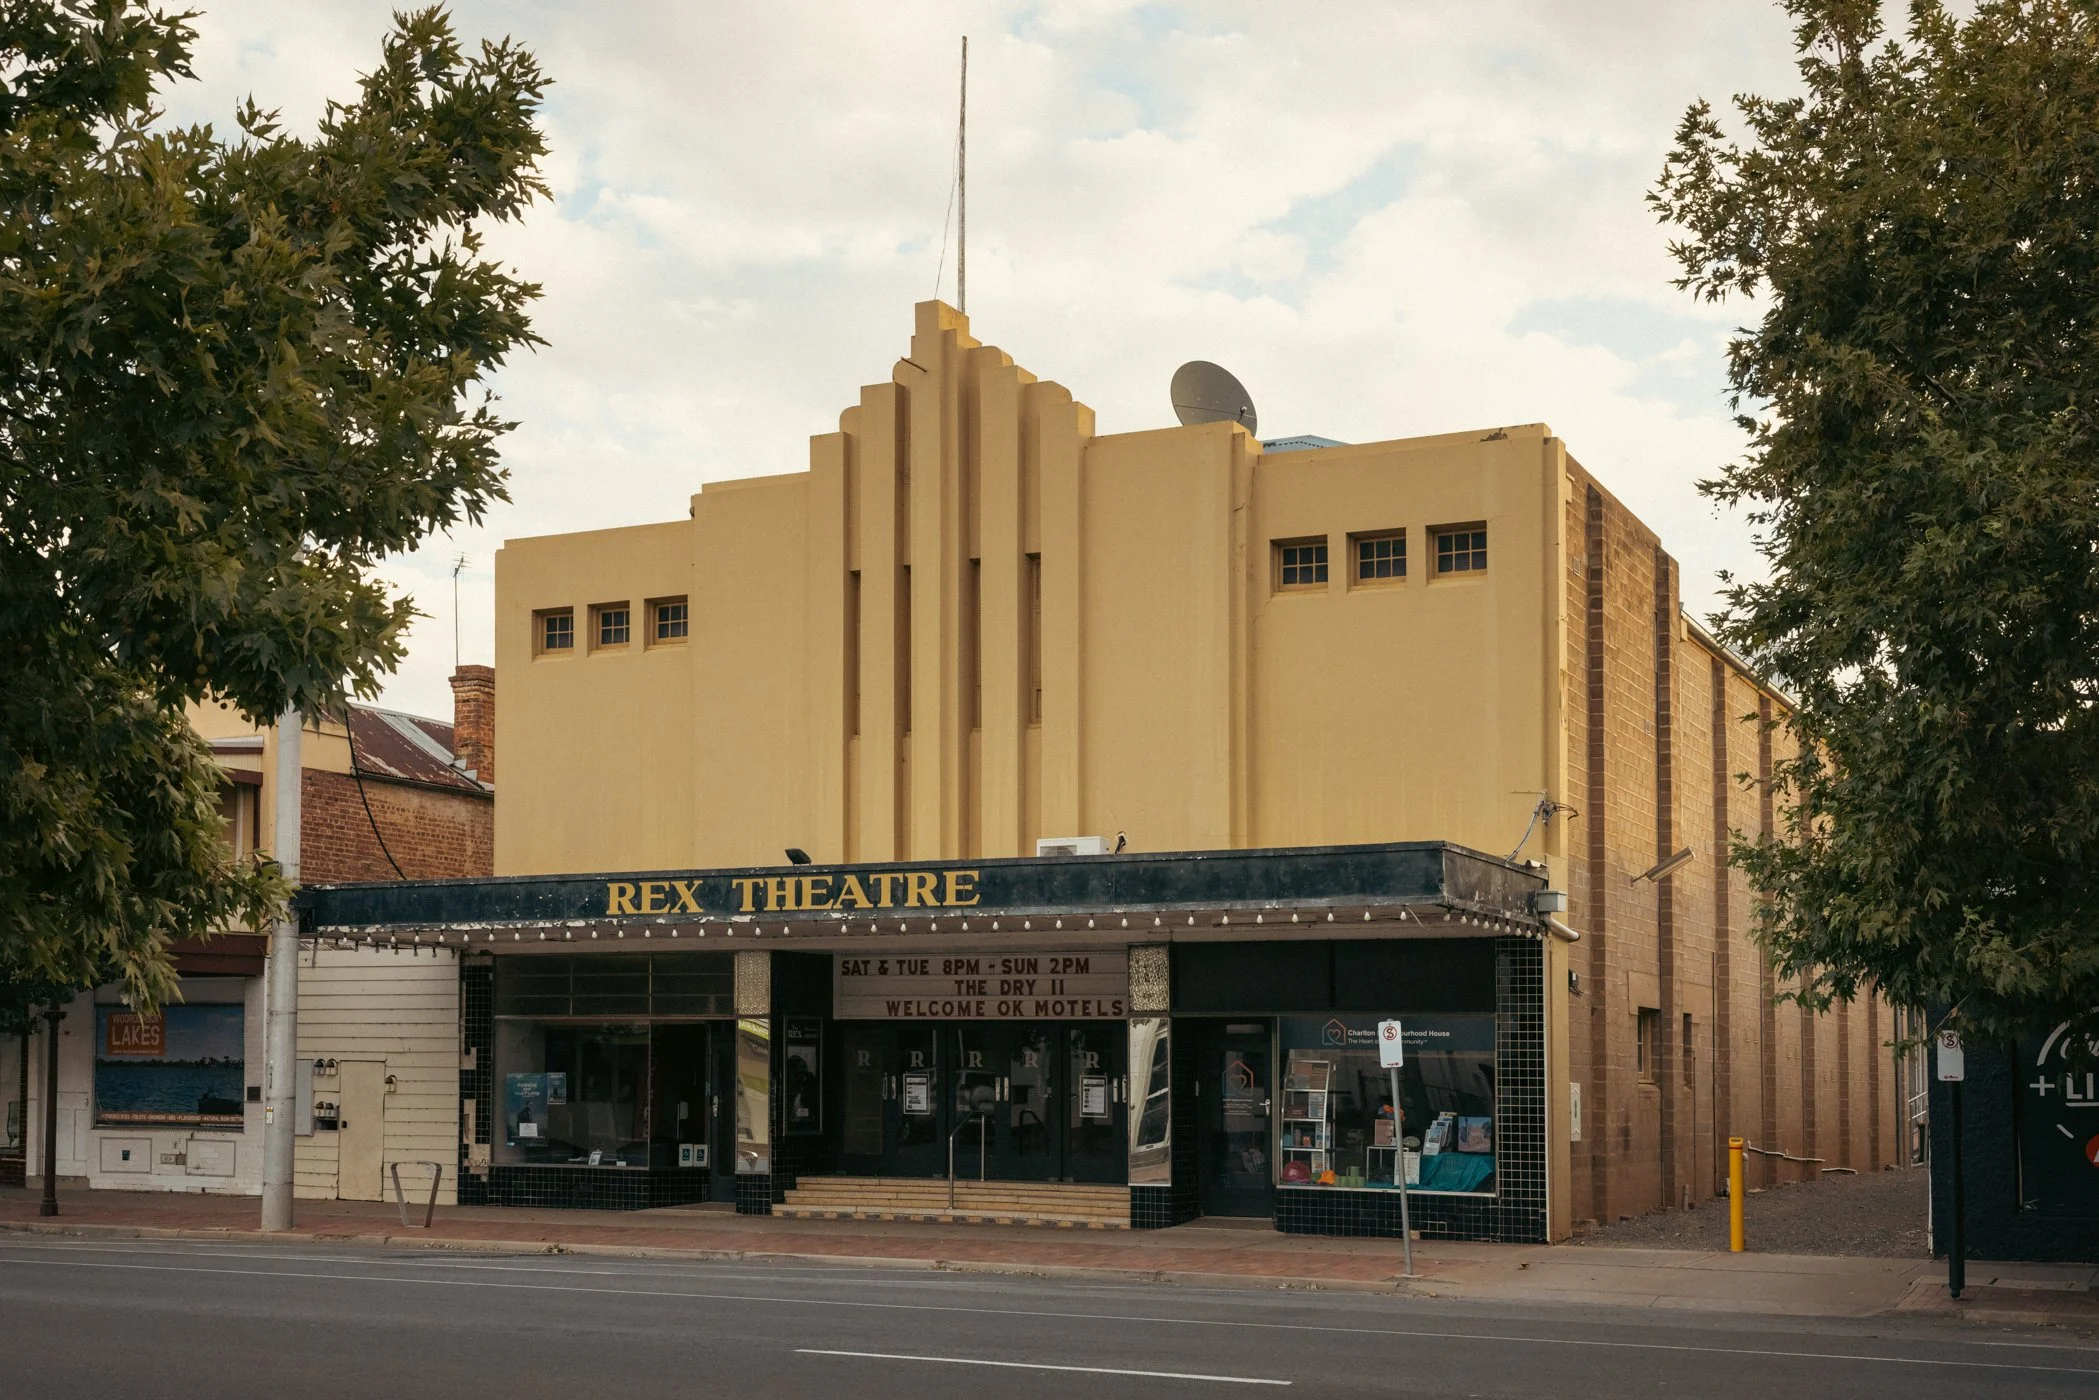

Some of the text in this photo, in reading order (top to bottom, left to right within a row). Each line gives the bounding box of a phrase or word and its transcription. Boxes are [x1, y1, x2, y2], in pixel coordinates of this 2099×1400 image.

[606, 870, 981, 915] REX THEATRE
[841, 960, 871, 976] SAT
[878, 960, 889, 976] &
[896, 959, 930, 976] TUE
[942, 959, 980, 975] 8PM
[1001, 958, 1039, 975] SUN
[1049, 957, 1090, 974] 2PM
[954, 980, 988, 996] THE
[1000, 979, 1037, 996] DRY
[886, 1000, 1123, 1017] WELCOME OK MOTELS
[112, 1024, 160, 1046] LAKES
[788, 1029, 803, 1039] REX
[1347, 1029, 1376, 1037] Charlton
[857, 1050, 871, 1067] R
[909, 1050, 924, 1068] R
[968, 1050, 983, 1068] R
[1023, 1050, 1039, 1068] R
[1084, 1051, 1100, 1069] R
